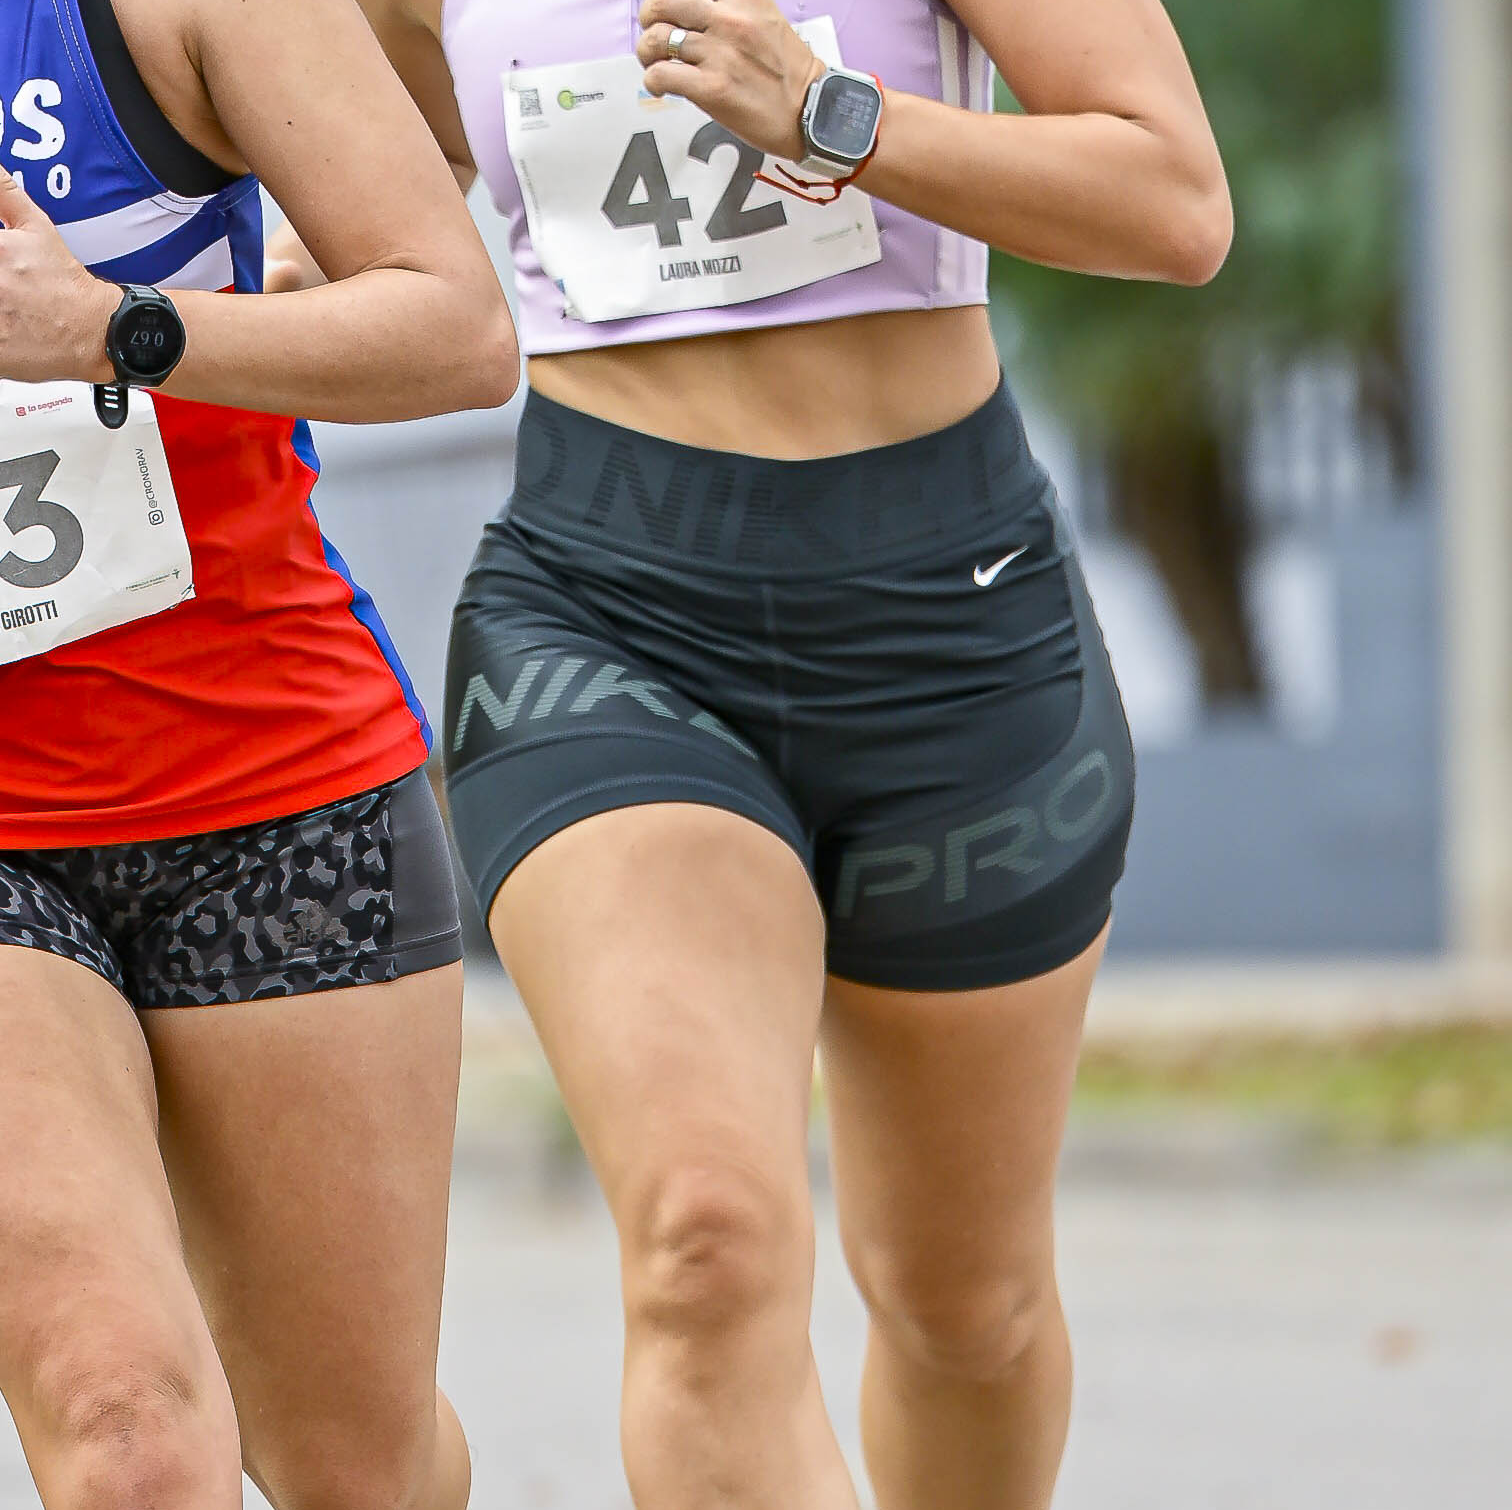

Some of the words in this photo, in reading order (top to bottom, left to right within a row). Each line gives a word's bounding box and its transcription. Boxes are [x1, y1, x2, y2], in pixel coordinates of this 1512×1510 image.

[601, 120, 788, 248] 42
[659, 260, 701, 282] LAURA
[701, 255, 742, 276] MOZZI
[0, 600, 59, 630] GIROTTI
[834, 748, 1114, 919] PRO
